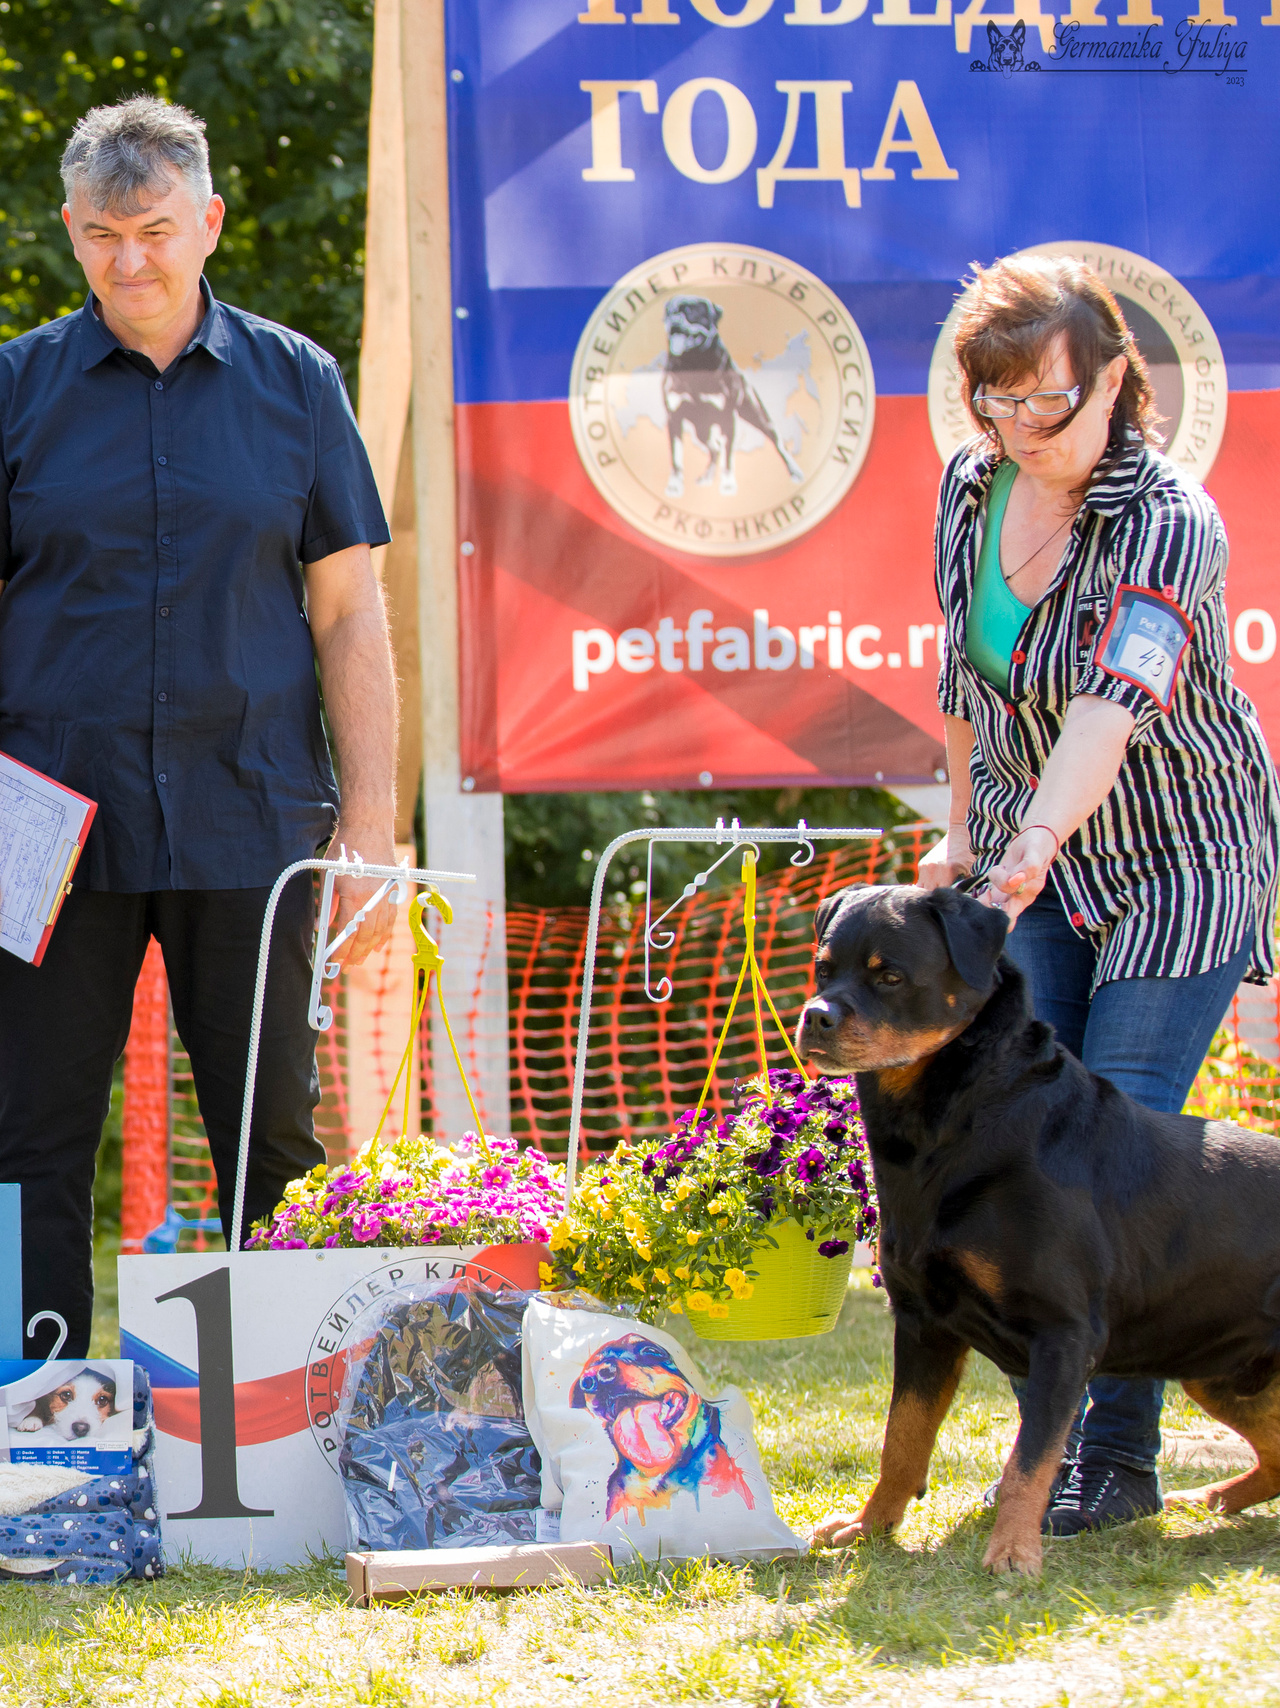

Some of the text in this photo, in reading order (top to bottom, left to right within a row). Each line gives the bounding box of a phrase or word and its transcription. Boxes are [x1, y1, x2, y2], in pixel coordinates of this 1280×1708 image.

[579, 76, 960, 209] ГОДА
[712, 256, 809, 302] КЛУБ
[817, 310, 864, 466] РОССИИ
[1082, 254, 1216, 464] ГИЧЕСКАЯ ФЕДЕРА
[571, 608, 945, 692] petfabric.r
[1138, 647, 1166, 677] 43
[154, 1266, 275, 1521] 1
[310, 1268, 405, 1454] РОТВЕЙЛЕР
